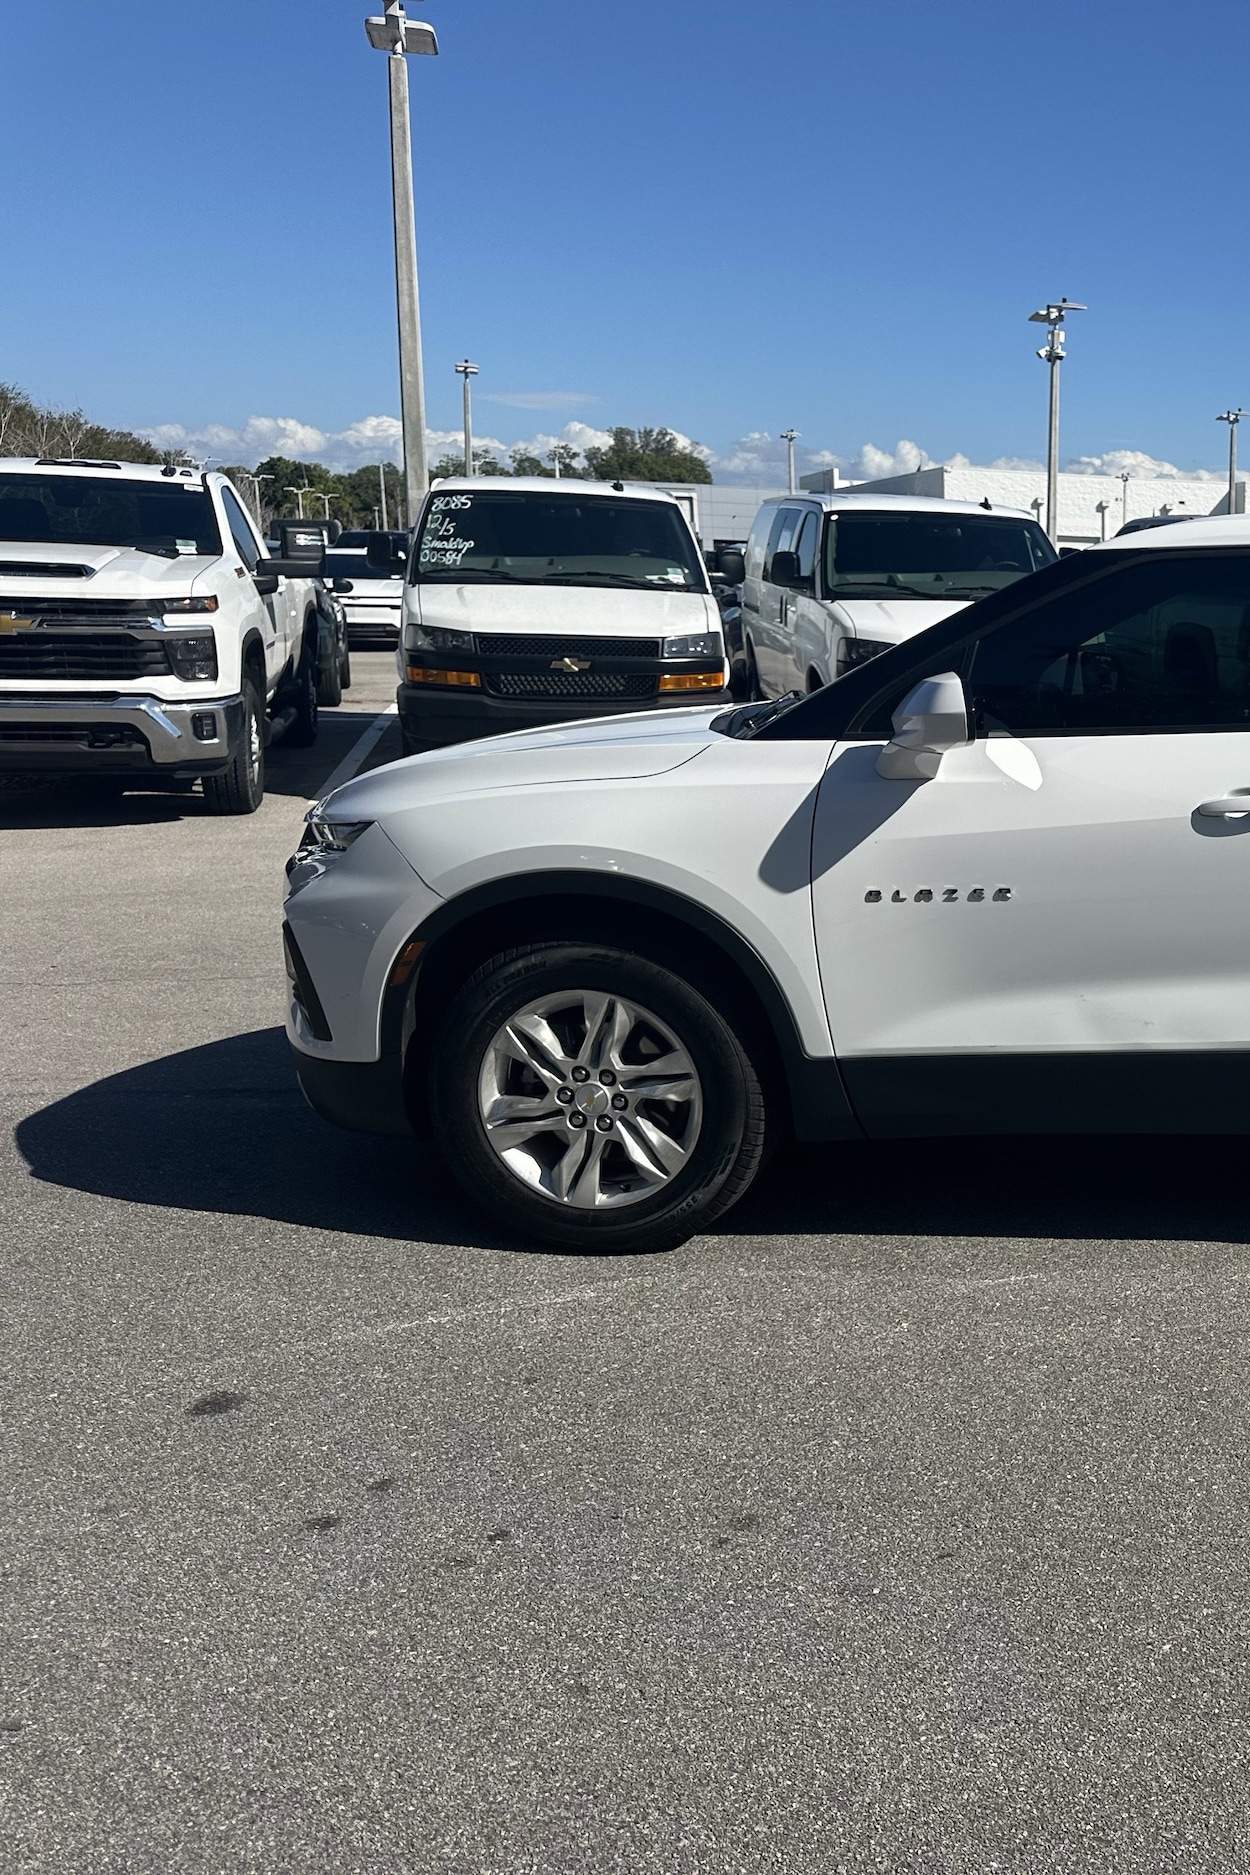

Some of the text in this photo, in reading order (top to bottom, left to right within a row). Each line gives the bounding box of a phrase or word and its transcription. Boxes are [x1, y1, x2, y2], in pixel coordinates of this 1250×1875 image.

[430, 494, 474, 511] 8085
[426, 513, 456, 535] 12/5
[420, 549, 463, 565] 00584
[864, 887, 1012, 903] BLAZER
